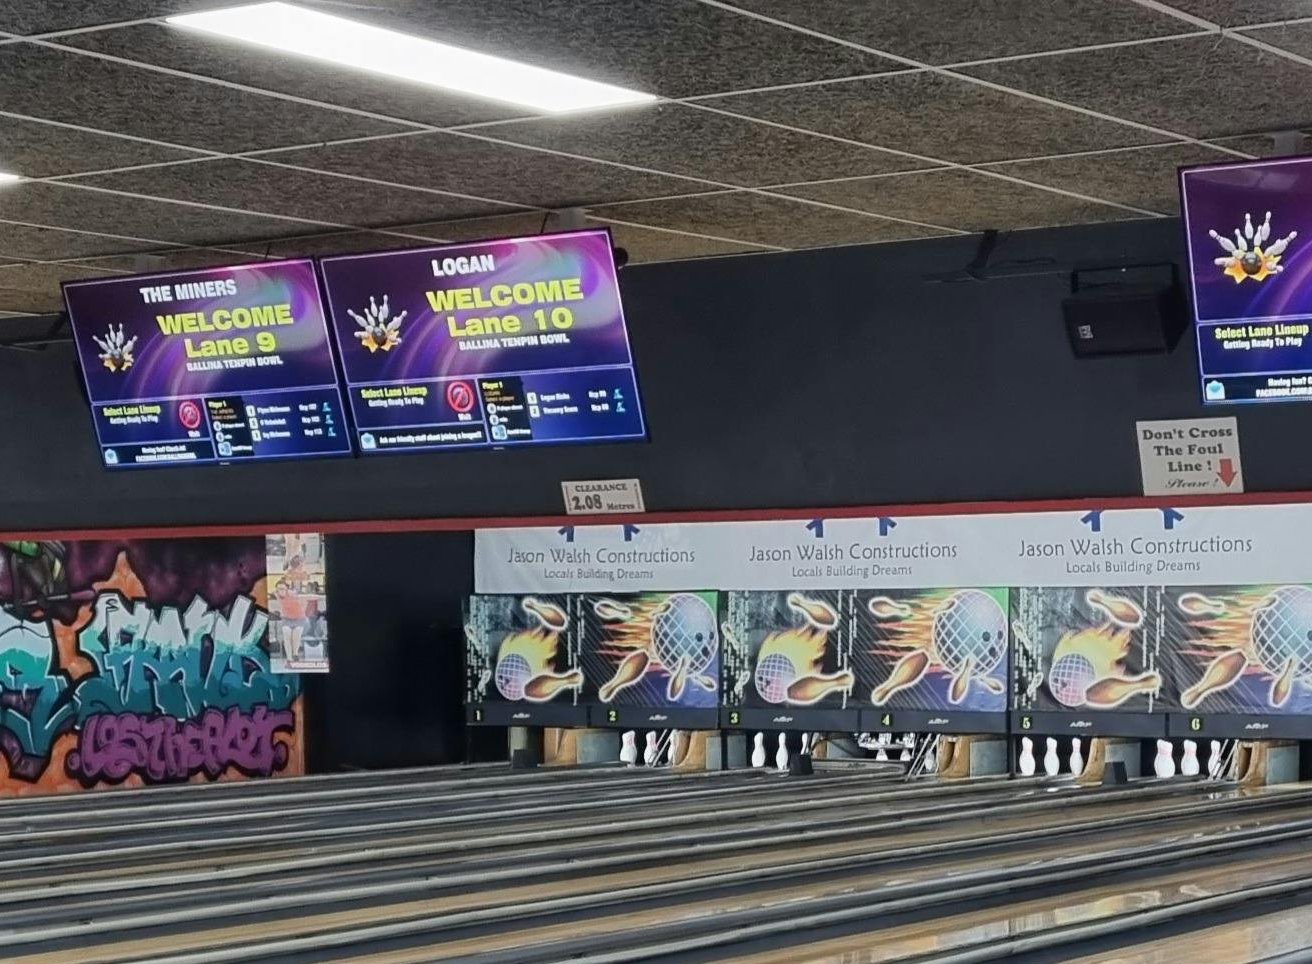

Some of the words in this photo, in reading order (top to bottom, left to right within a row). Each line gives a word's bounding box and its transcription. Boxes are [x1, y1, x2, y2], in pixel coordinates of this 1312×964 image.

[432, 255, 494, 277] LOGAN
[140, 287, 170, 303] THE
[175, 280, 237, 299] MINERS
[426, 279, 583, 312] WELCOME
[157, 304, 294, 336] WELCOME
[447, 313, 520, 337] Lane
[533, 307, 573, 330] 10
[1215, 327, 1246, 339] Select
[1248, 326, 1272, 337] Lane
[1275, 324, 1309, 336] Lineup
[184, 337, 248, 358] Lane
[255, 335, 276, 354] 9
[459, 339, 498, 350] BALLINA
[501, 336, 538, 348] TENPIN
[542, 334, 569, 344] BOWL
[1224, 340, 1250, 350] Getting
[1252, 339, 1274, 349] Ready
[1275, 338, 1284, 346] To
[1286, 337, 1302, 347] Play
[187, 360, 222, 371] BALLINA
[224, 358, 256, 369] TENPIN
[258, 356, 282, 366] BOWL
[1143, 429, 1184, 440] Don't
[1190, 428, 1232, 438] Cross
[1153, 446, 1182, 456] The
[1187, 444, 1223, 455] Foul
[1168, 462, 1202, 472] Line
[575, 484, 627, 492] CLEARANCE
[1166, 479, 1209, 489] Please
[572, 494, 602, 510] 2.08
[749, 546, 791, 562] Jason
[797, 543, 844, 561] Walsh
[849, 542, 957, 559] Constructions
[1019, 540, 1064, 557] Jason
[1070, 537, 1124, 555] Walsh
[1131, 535, 1253, 554] Constructions
[508, 548, 545, 565] Jason
[550, 546, 591, 564] Walsh
[596, 546, 695, 563] Constructions
[792, 566, 822, 578] Locals
[826, 565, 868, 578] Building
[872, 564, 912, 576] Dreams
[1066, 561, 1101, 574] Locals
[1104, 560, 1152, 575] Building
[1156, 559, 1201, 572] Dreams
[544, 569, 573, 580] Locals
[576, 568, 614, 581] Building
[617, 568, 654, 579] Dreams
[474, 710, 481, 722] 1
[608, 710, 617, 721] 2
[730, 712, 738, 724] 3
[882, 714, 890, 726] 4
[1022, 717, 1031, 730] 5
[1191, 718, 1200, 731] 6
